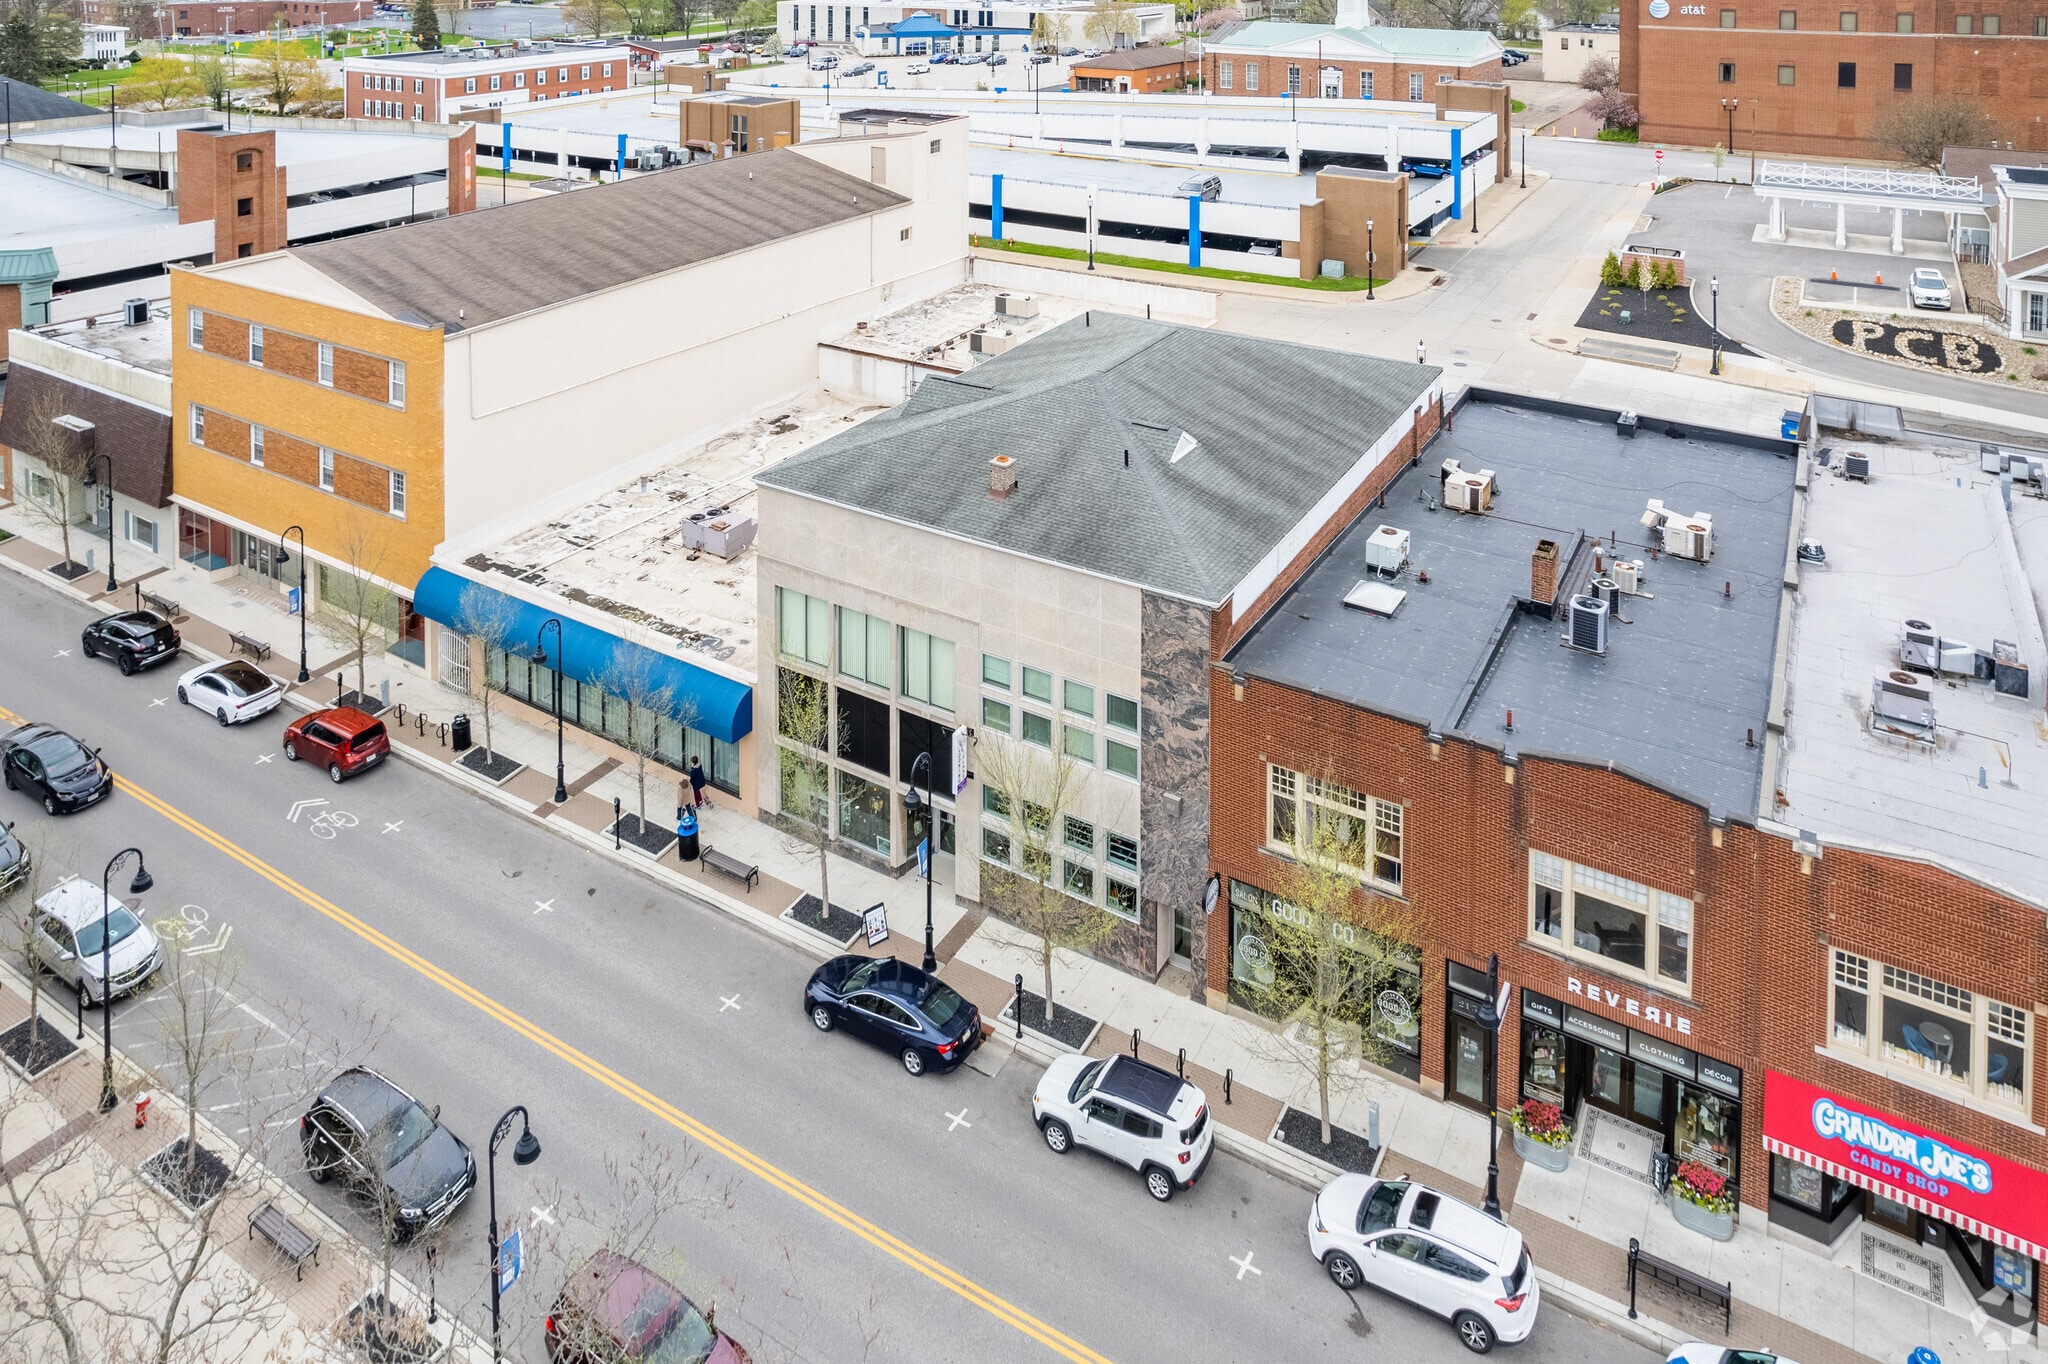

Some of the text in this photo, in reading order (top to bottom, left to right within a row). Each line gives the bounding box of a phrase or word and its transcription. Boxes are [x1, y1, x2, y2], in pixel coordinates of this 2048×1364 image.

[1680, 4, 1706, 15] at&t
[1851, 320, 1983, 371] PCB
[1234, 888, 1258, 905] SALON
[1377, 998, 1398, 1013] GOOD
[1531, 1002, 1553, 1015] GIFTS
[1567, 976, 1691, 1035] REVERIE
[1568, 1016, 1621, 1041] ACCESSORIES
[1639, 1043, 1685, 1065] CLOTHING
[1704, 1067, 1733, 1084] DÉCOR
[1814, 1101, 1990, 1192] GRANDPA JOE'S
[1850, 1150, 1949, 1197] CANDY SHOP
